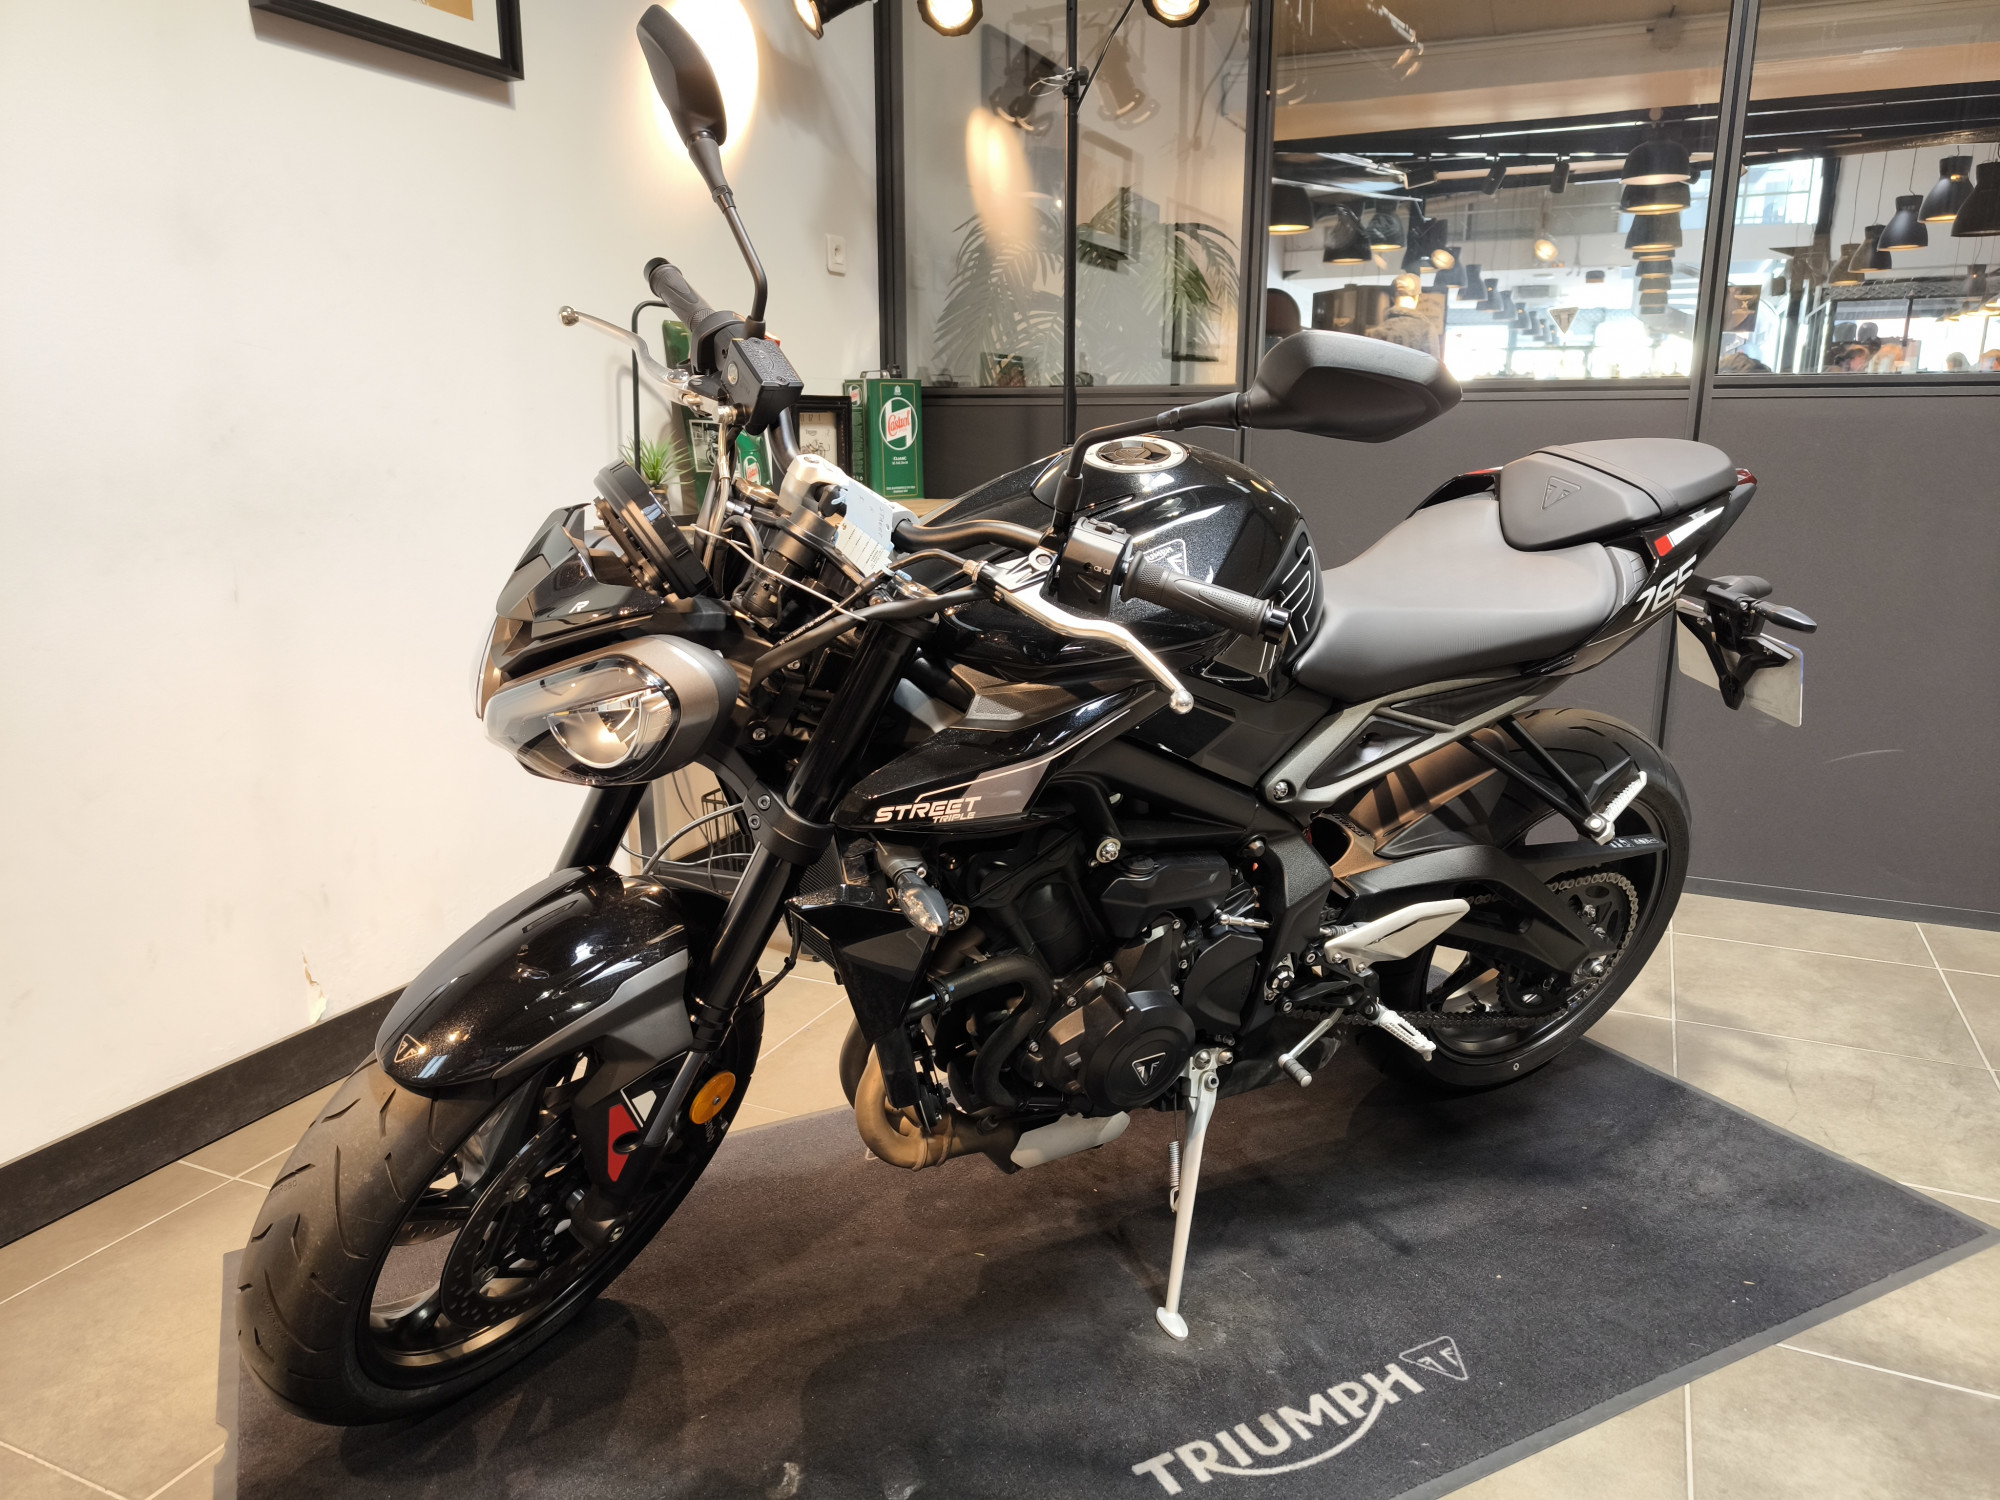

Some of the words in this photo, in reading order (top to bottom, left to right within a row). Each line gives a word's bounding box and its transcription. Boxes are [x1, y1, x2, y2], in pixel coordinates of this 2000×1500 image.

[888, 409, 911, 437] Castrol
[1633, 554, 1697, 622] 765
[874, 796, 982, 823] STREET
[933, 812, 976, 824] TRIPLE
[1131, 1363, 1425, 1495] TRIUMPH
